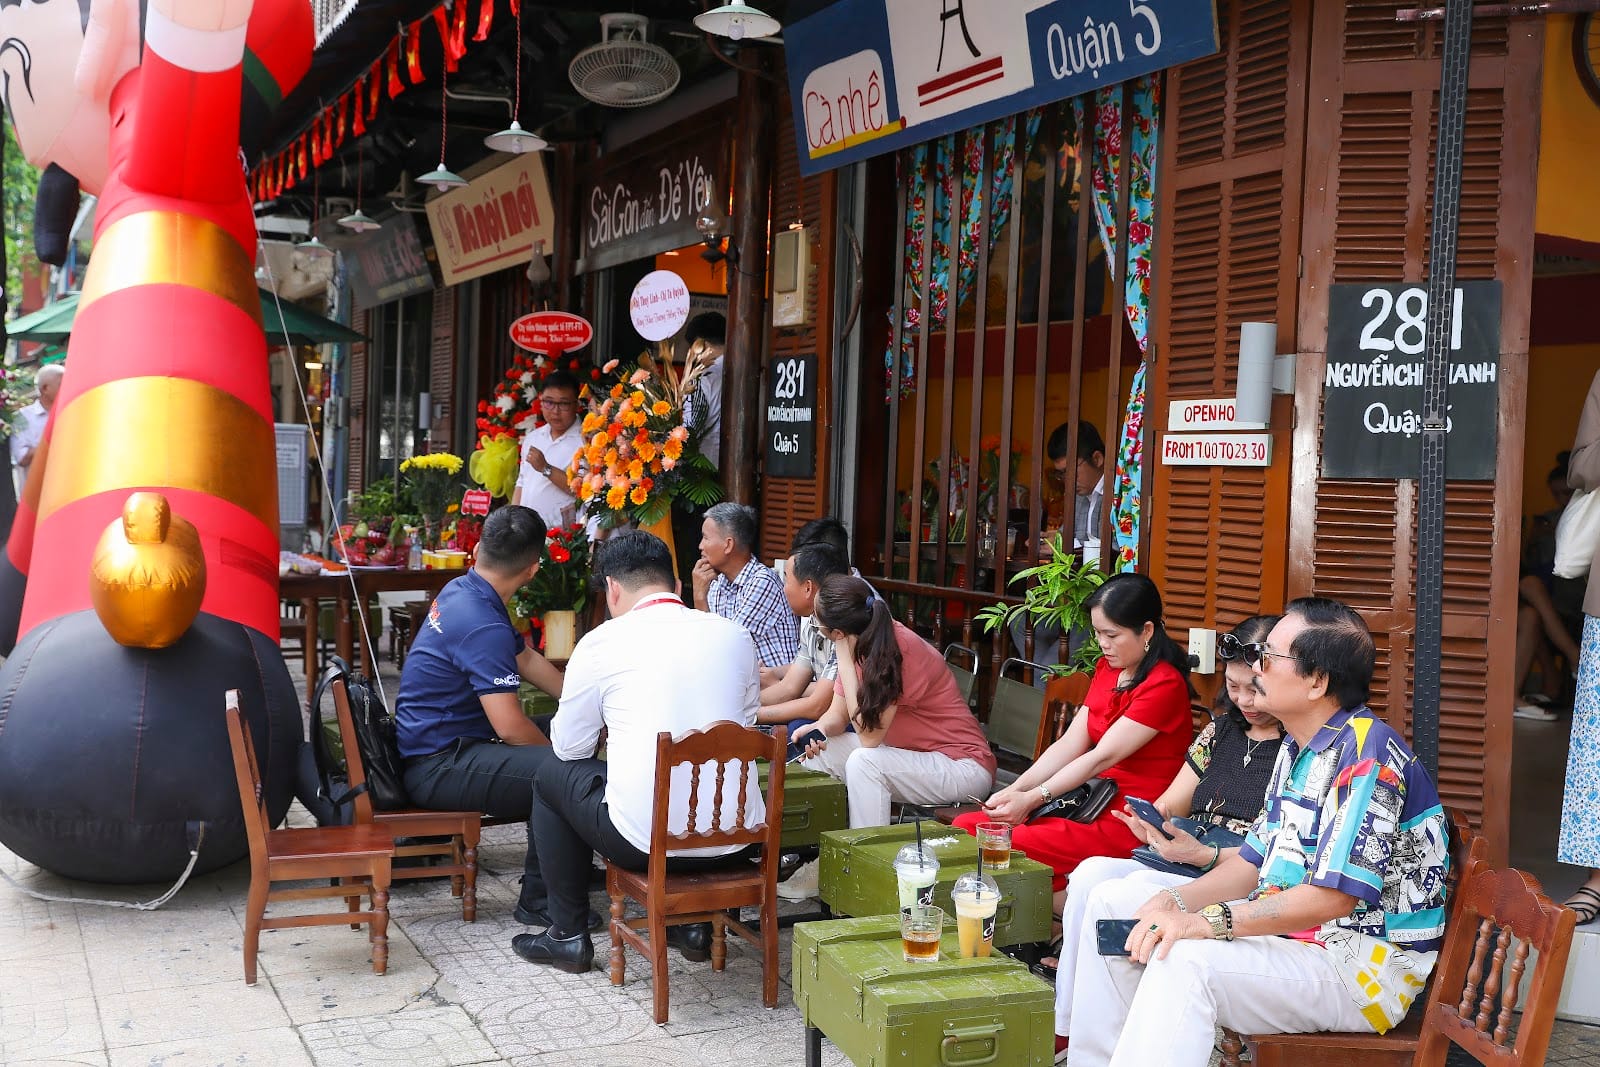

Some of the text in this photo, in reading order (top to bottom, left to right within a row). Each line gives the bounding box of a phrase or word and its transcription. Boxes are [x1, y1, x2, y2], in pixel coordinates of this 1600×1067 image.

[1047, 0, 1161, 80] Quận 5
[775, 358, 806, 399] 281
[1184, 404, 1217, 423] OPEN
[774, 431, 799, 456] Quận 5
[1165, 440, 1194, 459] FROM
[1219, 441, 1234, 459] TO
